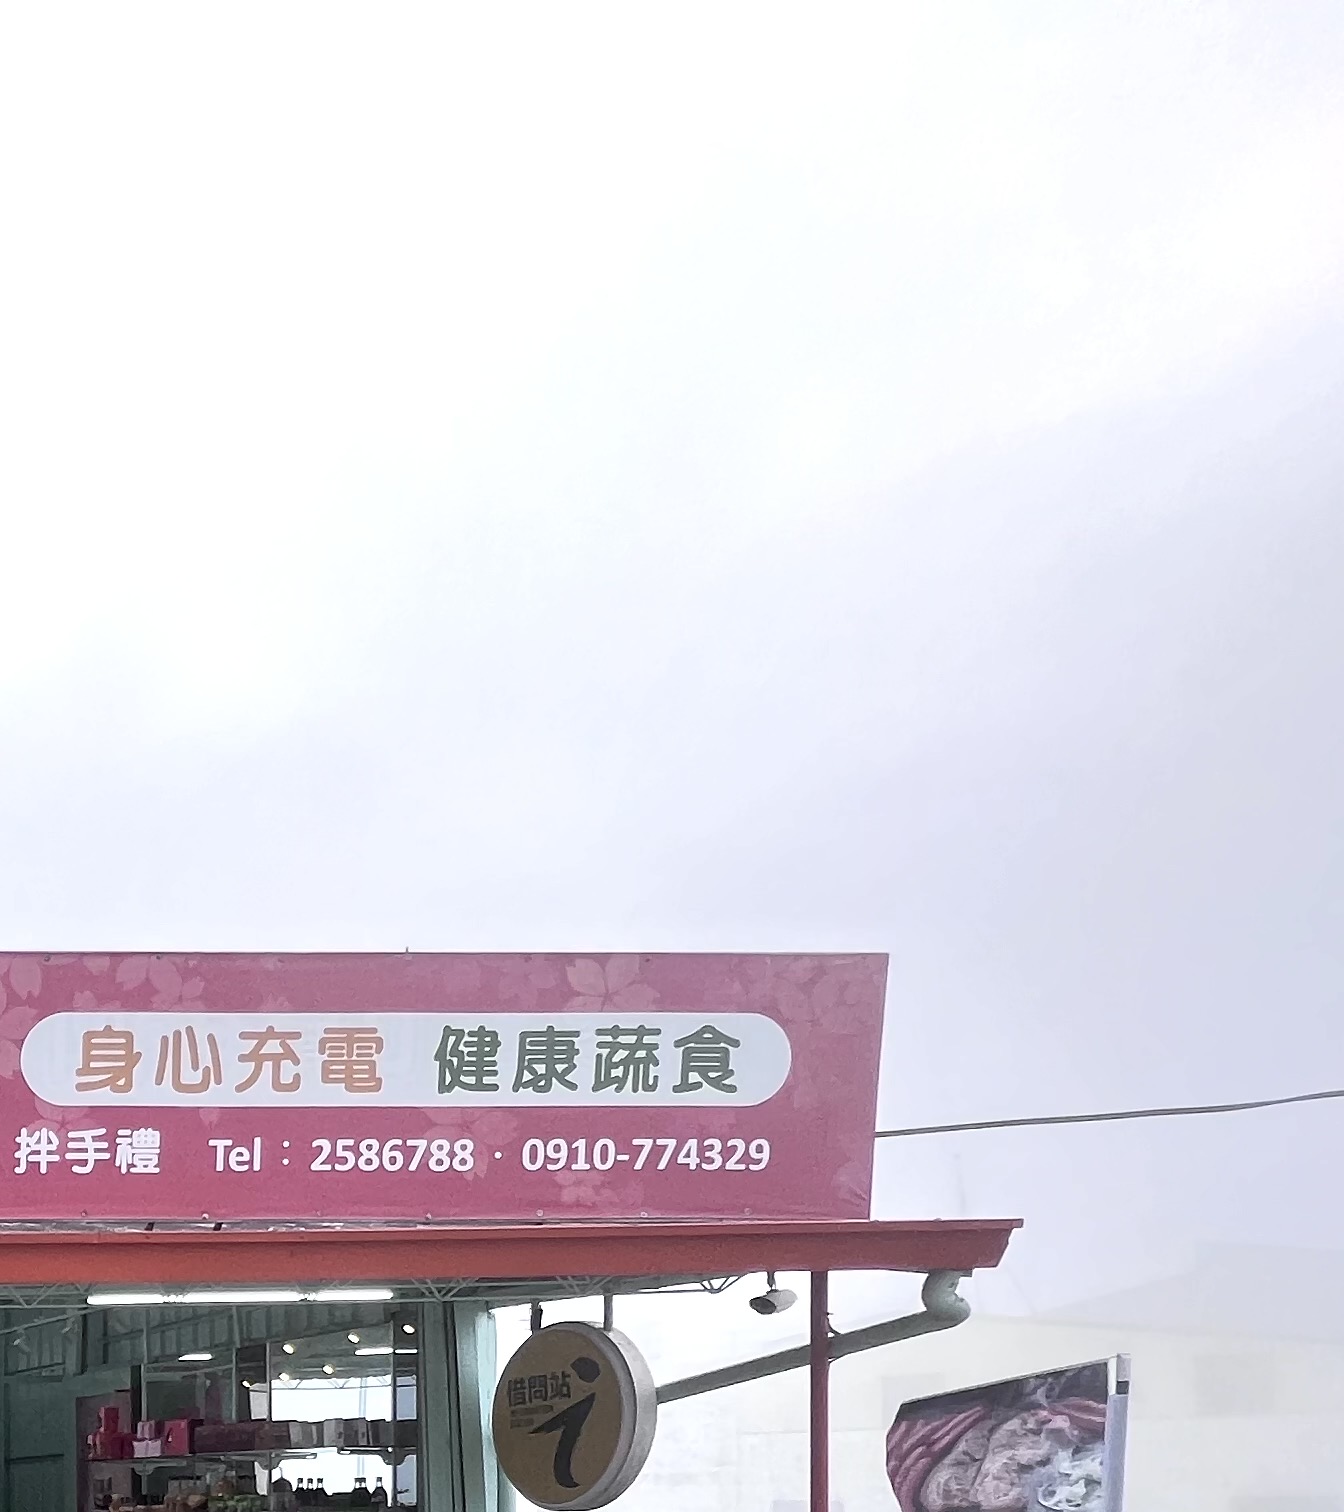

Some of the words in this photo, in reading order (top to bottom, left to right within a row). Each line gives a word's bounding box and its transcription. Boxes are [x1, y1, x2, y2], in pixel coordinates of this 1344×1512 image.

[74, 1024, 385, 1095] 身心充電
[433, 1023, 742, 1096] 健康蔬食
[13, 1126, 162, 1175] 拌手禮
[309, 1136, 475, 1172] 2586788
[520, 1136, 771, 1173] 0910-774329
[507, 1371, 572, 1407] 借問站
